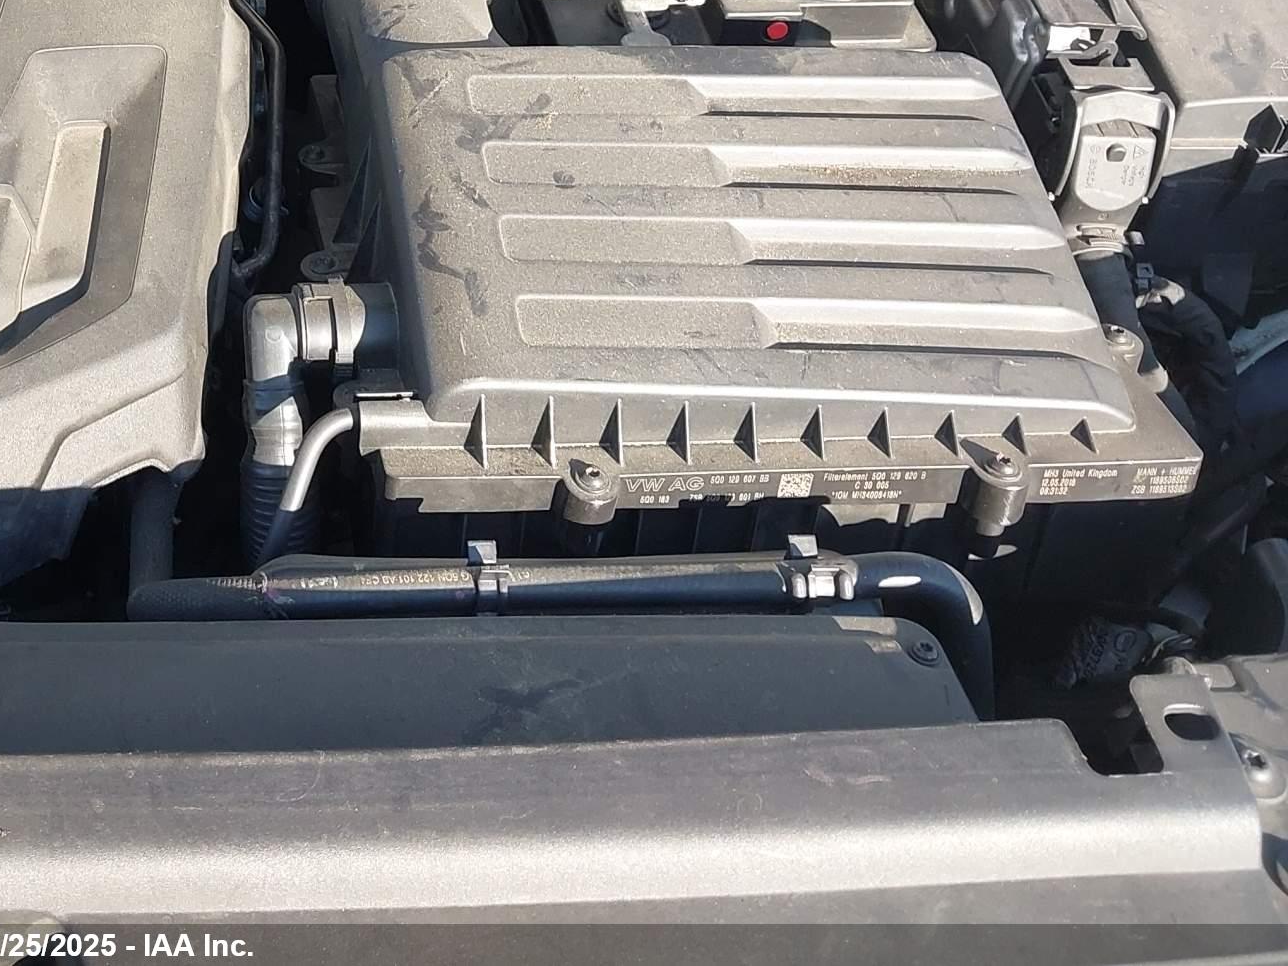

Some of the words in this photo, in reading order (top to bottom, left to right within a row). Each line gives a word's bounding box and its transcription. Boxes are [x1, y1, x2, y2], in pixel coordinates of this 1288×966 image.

[1062, 468, 1085, 478] United
[1088, 468, 1118, 479] Kingdom
[1136, 467, 1158, 476] MANN
[823, 472, 869, 481] Filterelement
[625, 478, 665, 492] VW
[668, 476, 705, 492] AG
[854, 481, 861, 490] C
